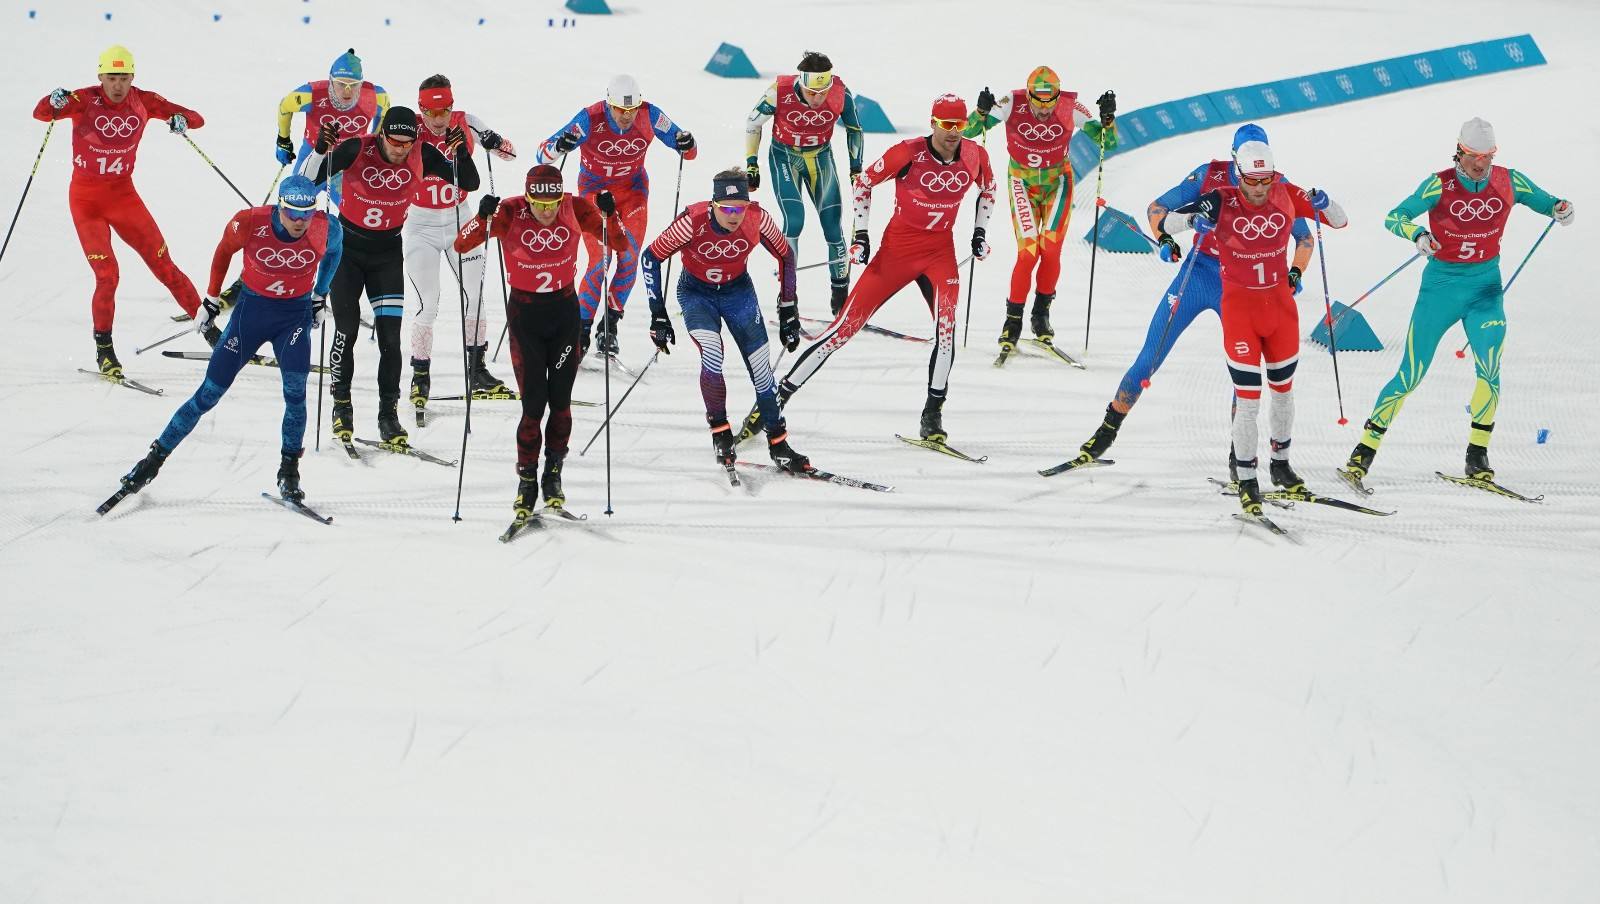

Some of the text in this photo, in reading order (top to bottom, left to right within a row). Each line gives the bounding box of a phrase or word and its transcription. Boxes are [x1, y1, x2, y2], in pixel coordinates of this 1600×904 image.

[791, 134, 819, 147] 13
[96, 157, 124, 175] 14
[1027, 153, 1043, 168] 9
[603, 165, 632, 177] 12
[427, 184, 455, 205] 10
[363, 207, 384, 228] 8
[925, 211, 944, 230] 7
[1457, 241, 1477, 260] 5
[535, 272, 554, 293] 2
[643, 256, 657, 300] USA
[705, 268, 723, 283] 6
[1252, 262, 1266, 284] 1
[265, 280, 287, 296] 4
[330, 330, 347, 384] ESTONIA
[555, 345, 572, 369] odlo
